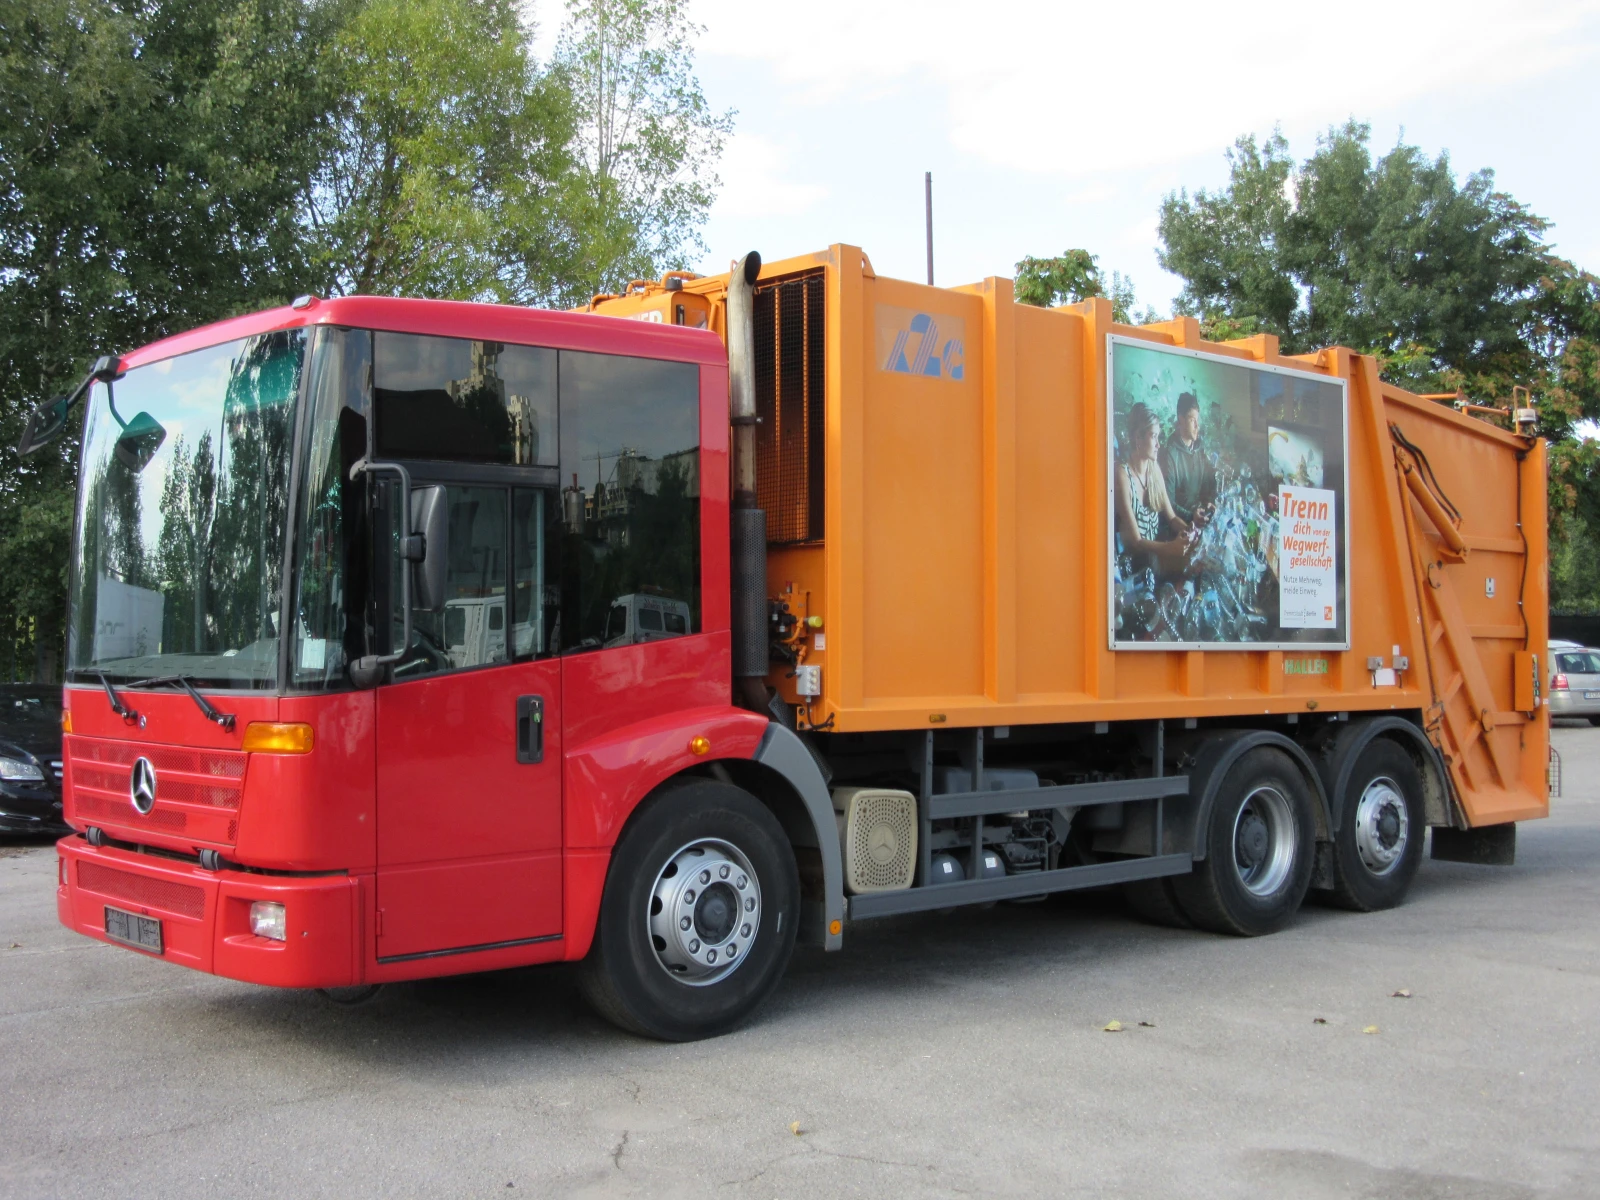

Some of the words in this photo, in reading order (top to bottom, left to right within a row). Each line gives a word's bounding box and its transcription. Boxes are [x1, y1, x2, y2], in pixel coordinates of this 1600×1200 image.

[1282, 492, 1328, 520] Trenn
[1293, 520, 1311, 535] dich
[1322, 528, 1331, 537] der
[1283, 535, 1329, 557] Wegwerf-
[1290, 554, 1332, 571] gesellschaft
[1283, 575, 1298, 584] Nutze
[1283, 586, 1298, 595] meide
[1284, 658, 1328, 674] HALLER
